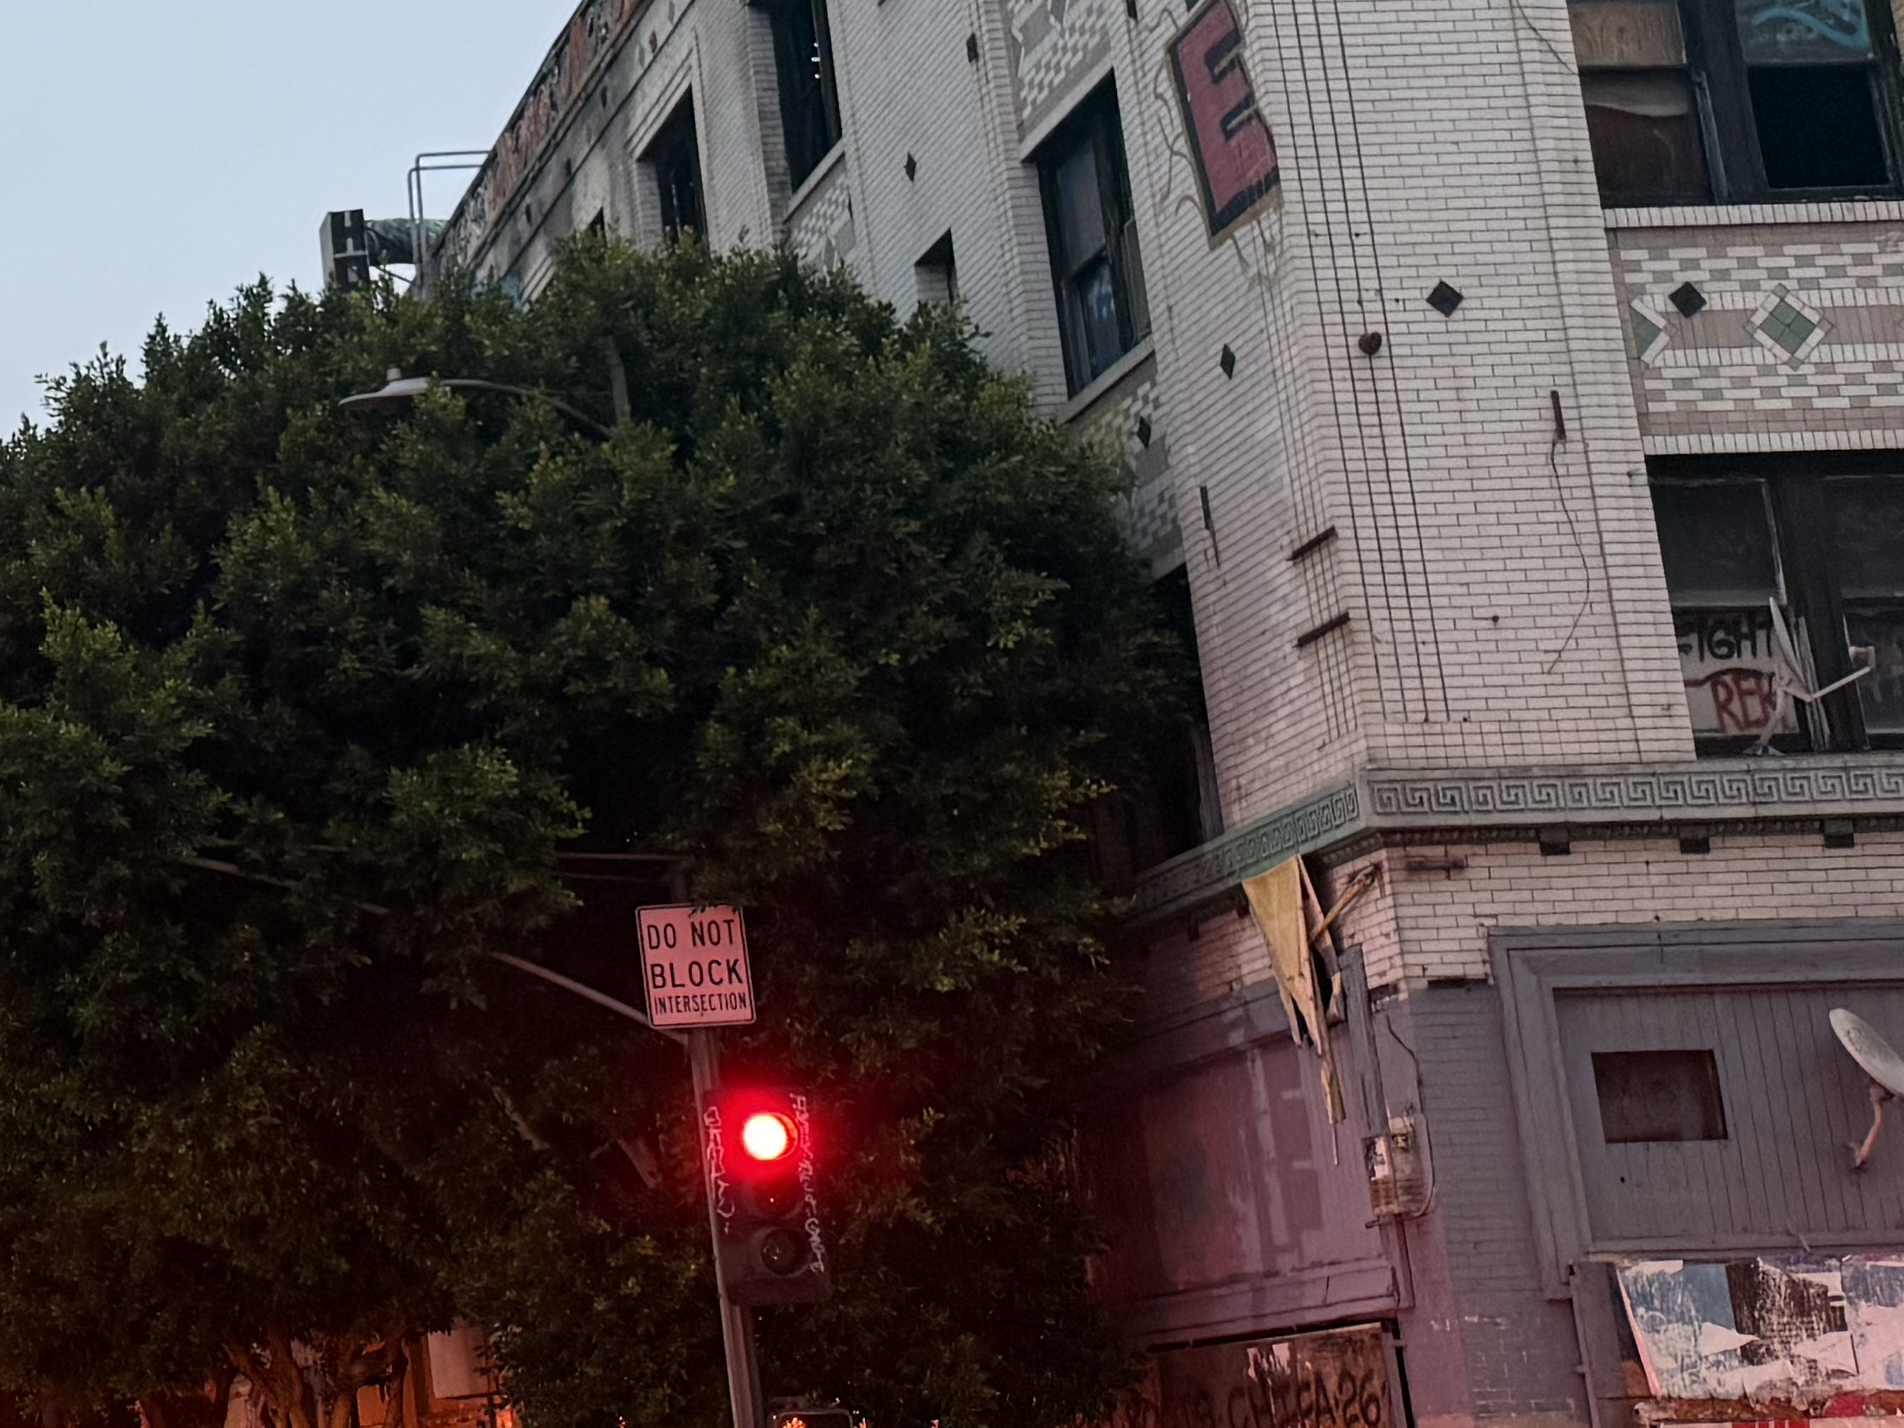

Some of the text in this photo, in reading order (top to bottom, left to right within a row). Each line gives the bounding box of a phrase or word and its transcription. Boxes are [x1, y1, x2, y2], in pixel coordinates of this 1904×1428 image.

[647, 919, 734, 950] DO NOT
[650, 958, 743, 989] BLOCK
[654, 992, 747, 1015] INTERSECTION
